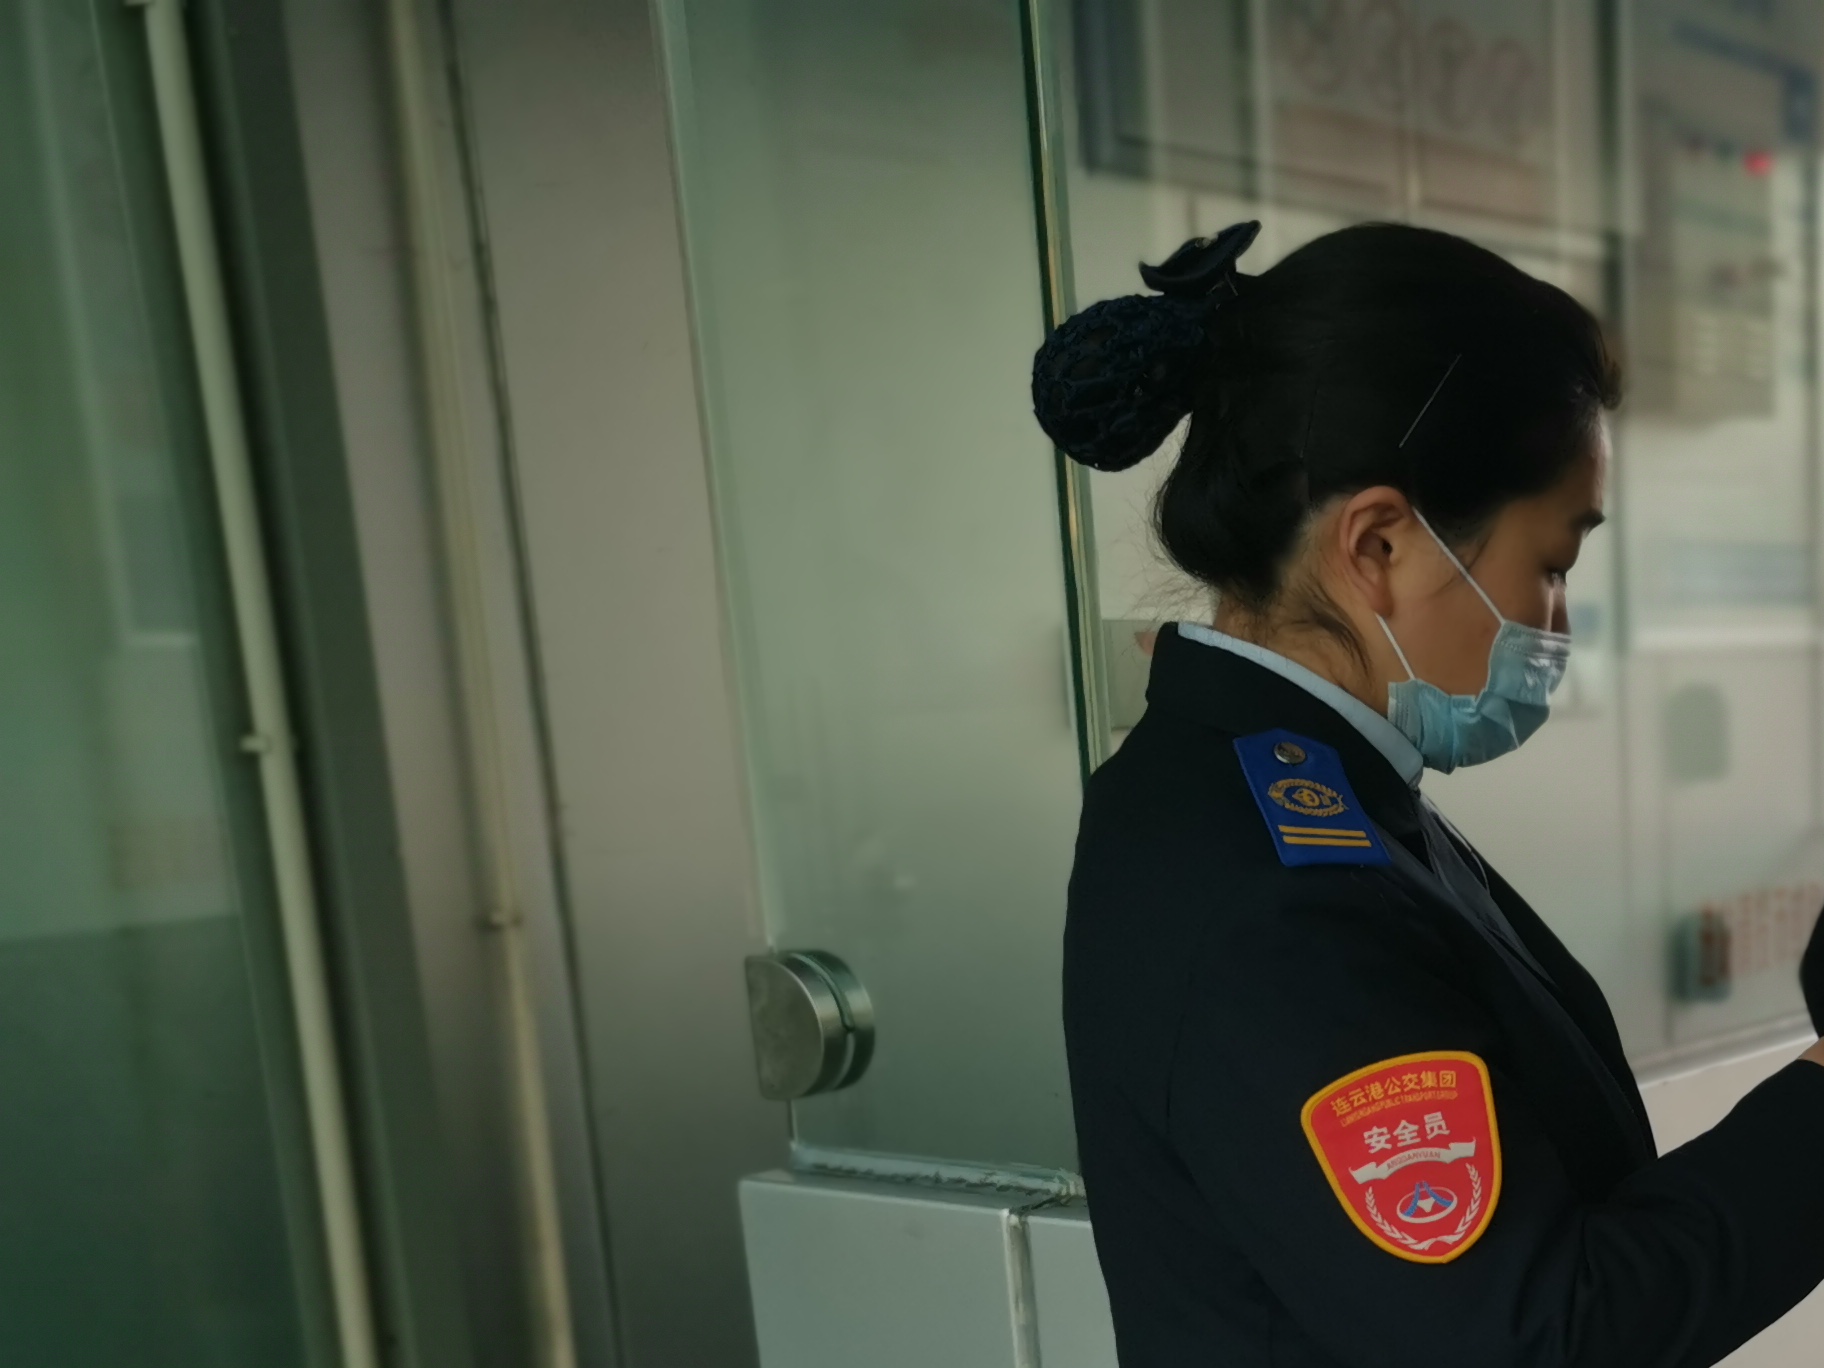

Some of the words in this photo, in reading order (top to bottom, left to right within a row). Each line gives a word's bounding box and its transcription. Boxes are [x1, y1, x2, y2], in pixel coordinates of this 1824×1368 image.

[1330, 1070, 1457, 1117] 连云港公交集团
[1363, 1111, 1450, 1154] 安全员
